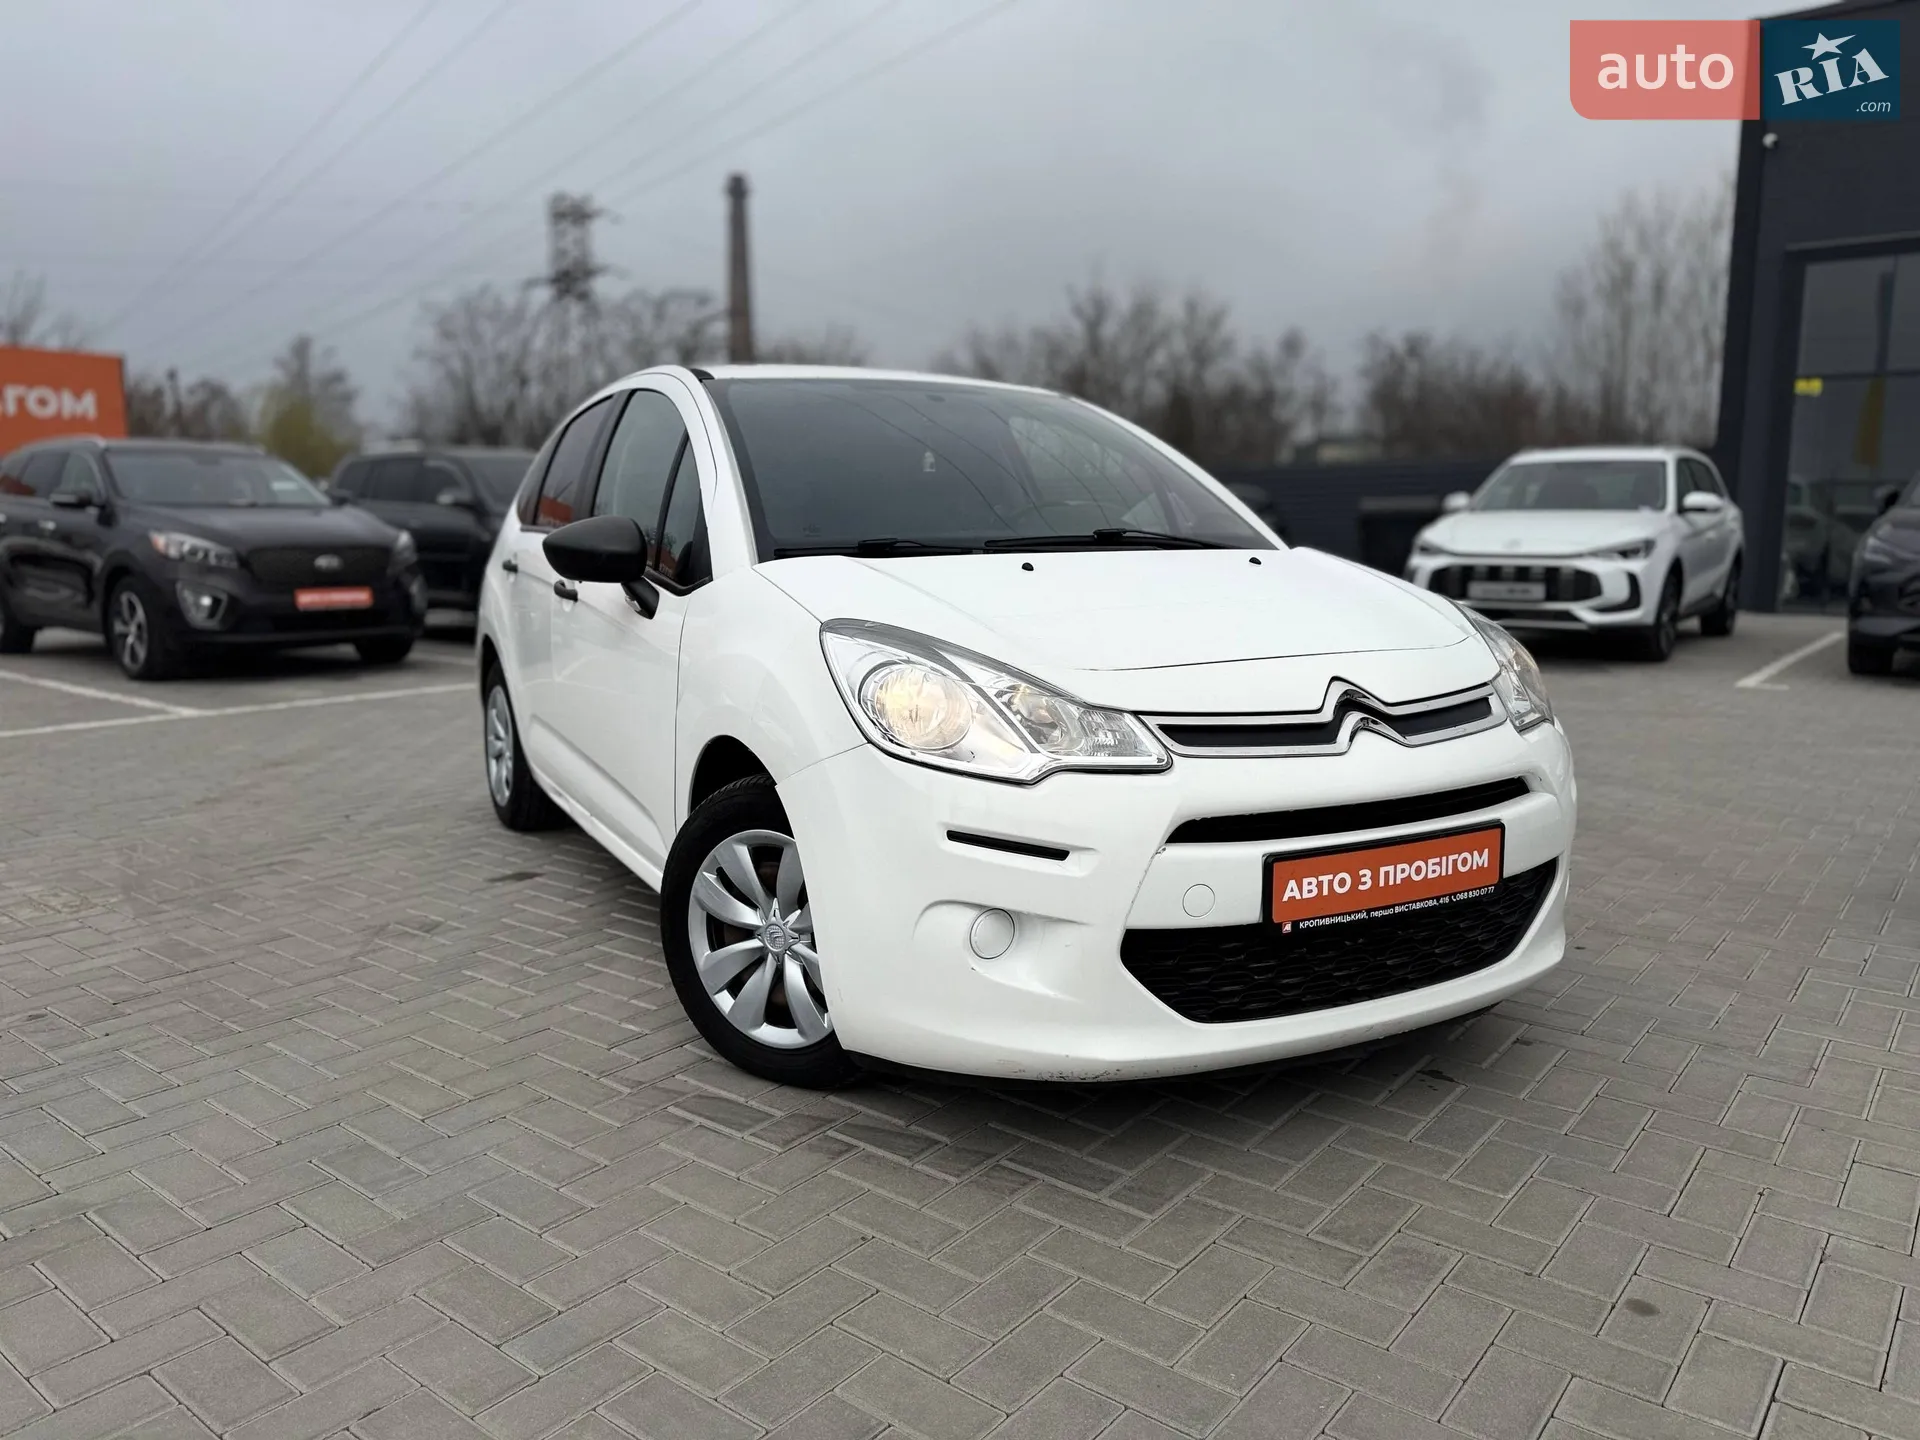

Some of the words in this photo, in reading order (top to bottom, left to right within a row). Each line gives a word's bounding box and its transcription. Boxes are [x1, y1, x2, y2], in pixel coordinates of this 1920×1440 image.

[1282, 871, 1352, 902] АВТО
[1379, 848, 1489, 887] ПРОБІГОМ
[1299, 910, 1368, 929] КРОПИВНИЦЬКИЙ,
